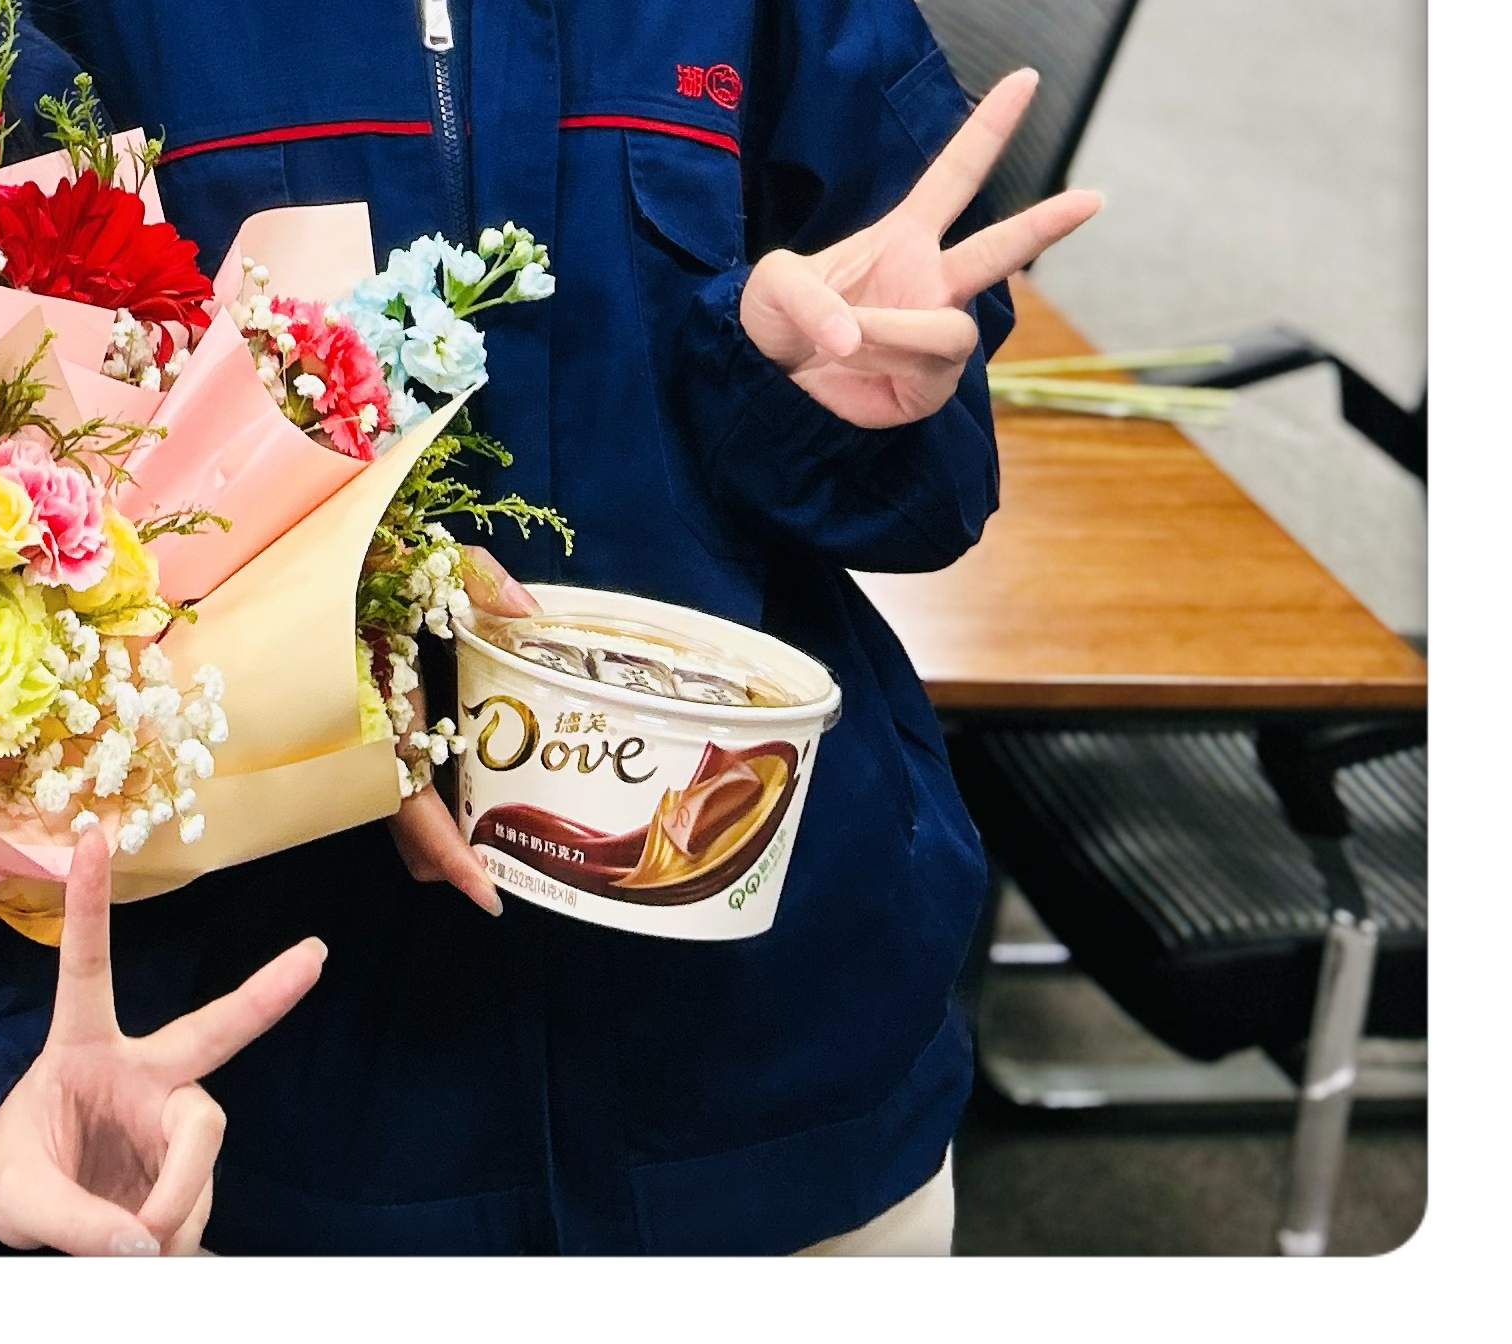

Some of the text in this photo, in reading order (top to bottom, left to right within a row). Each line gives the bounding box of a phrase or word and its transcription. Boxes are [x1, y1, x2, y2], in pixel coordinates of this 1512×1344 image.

[462, 695, 658, 784] Dove
[554, 711, 607, 735] 德芙
[495, 822, 585, 865] 丝滑牛奶巧克力
